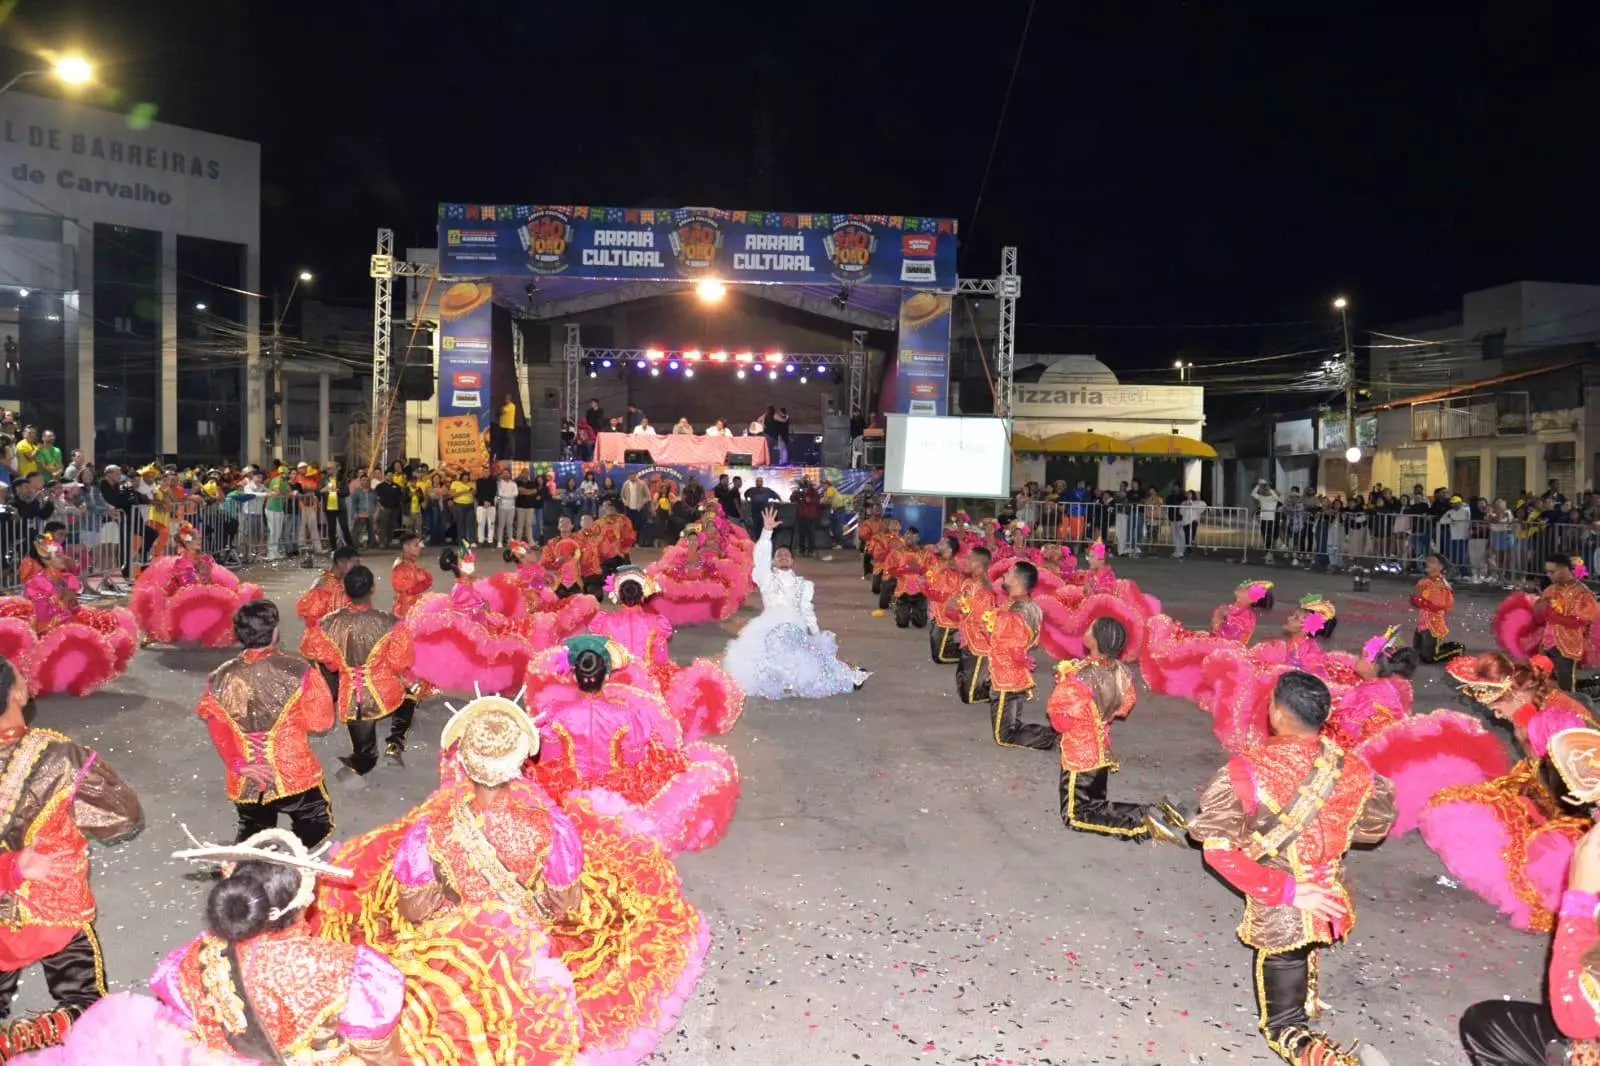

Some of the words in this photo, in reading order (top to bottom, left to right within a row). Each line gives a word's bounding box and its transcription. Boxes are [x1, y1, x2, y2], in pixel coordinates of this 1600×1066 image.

[29, 125, 61, 150] DE
[71, 133, 220, 180] BARREIRAS
[11, 162, 46, 185] de
[57, 168, 173, 206] Carvalho
[594, 227, 654, 248] ARRAIÁ
[745, 232, 805, 251] ARRAIÁ
[582, 249, 665, 267] CULTURAL
[733, 253, 816, 272] CULTURAL
